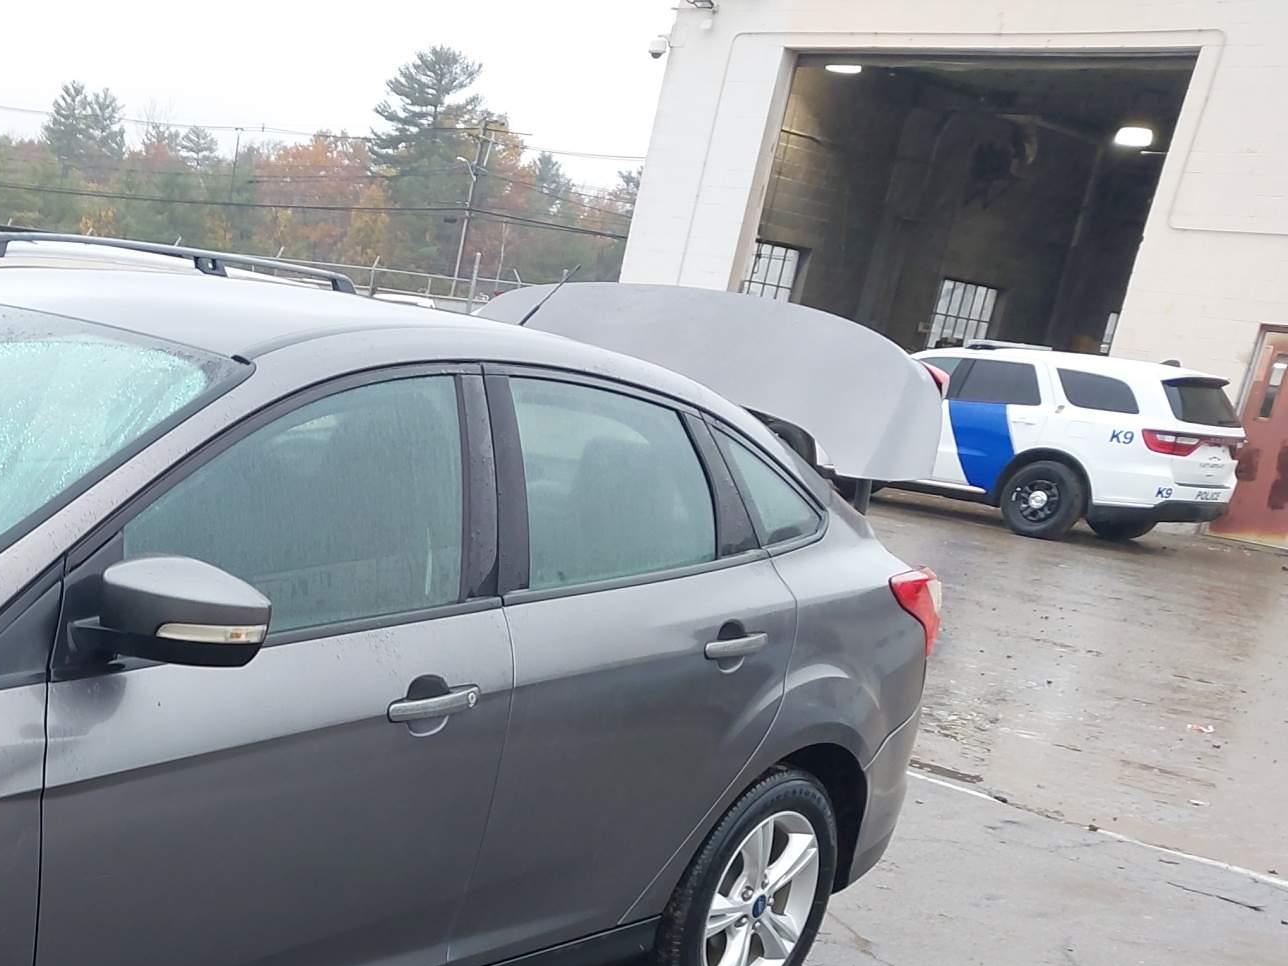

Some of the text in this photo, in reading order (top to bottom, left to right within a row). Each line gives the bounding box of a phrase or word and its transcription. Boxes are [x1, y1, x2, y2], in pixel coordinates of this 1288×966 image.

[1109, 429, 1135, 445] K9
[1155, 487, 1173, 499] K9
[1195, 491, 1222, 501] POLICE
